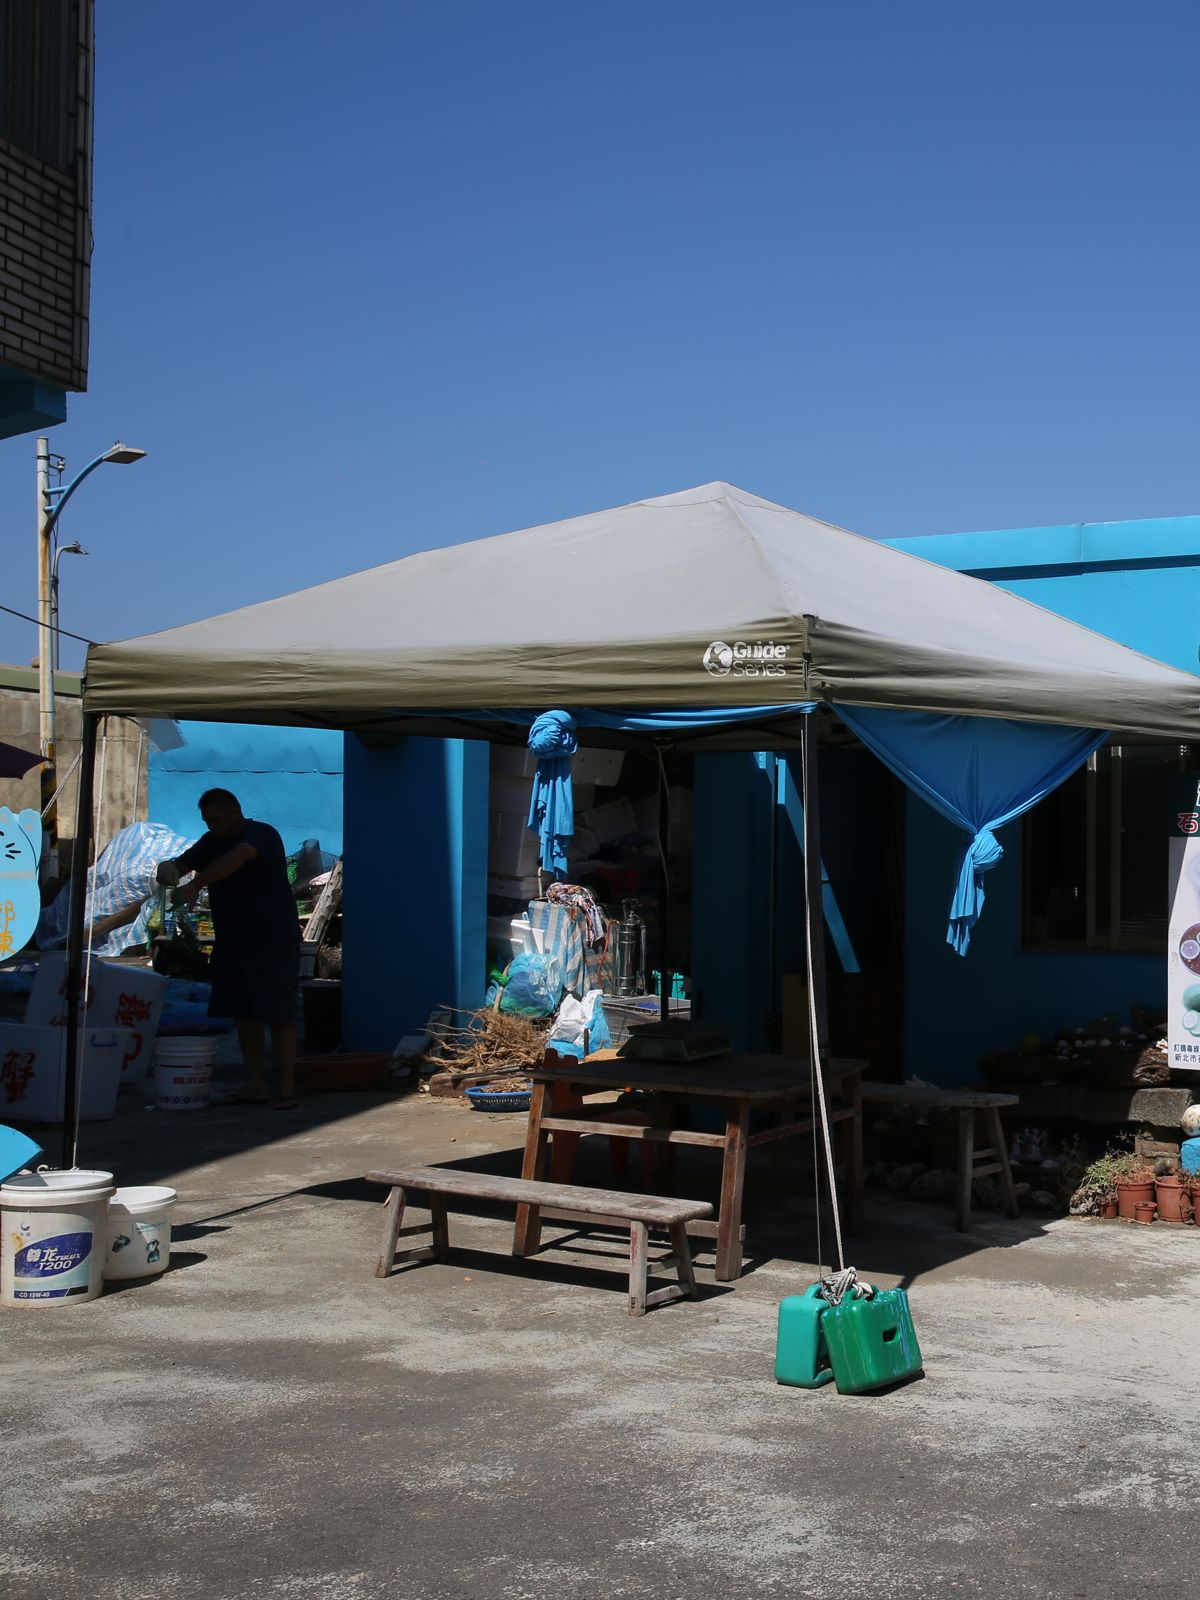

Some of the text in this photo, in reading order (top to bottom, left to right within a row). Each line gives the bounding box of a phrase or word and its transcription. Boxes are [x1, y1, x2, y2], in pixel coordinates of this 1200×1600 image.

[733, 641, 787, 659] Guide
[733, 661, 786, 677] Series
[39, 1260, 75, 1271] T200
